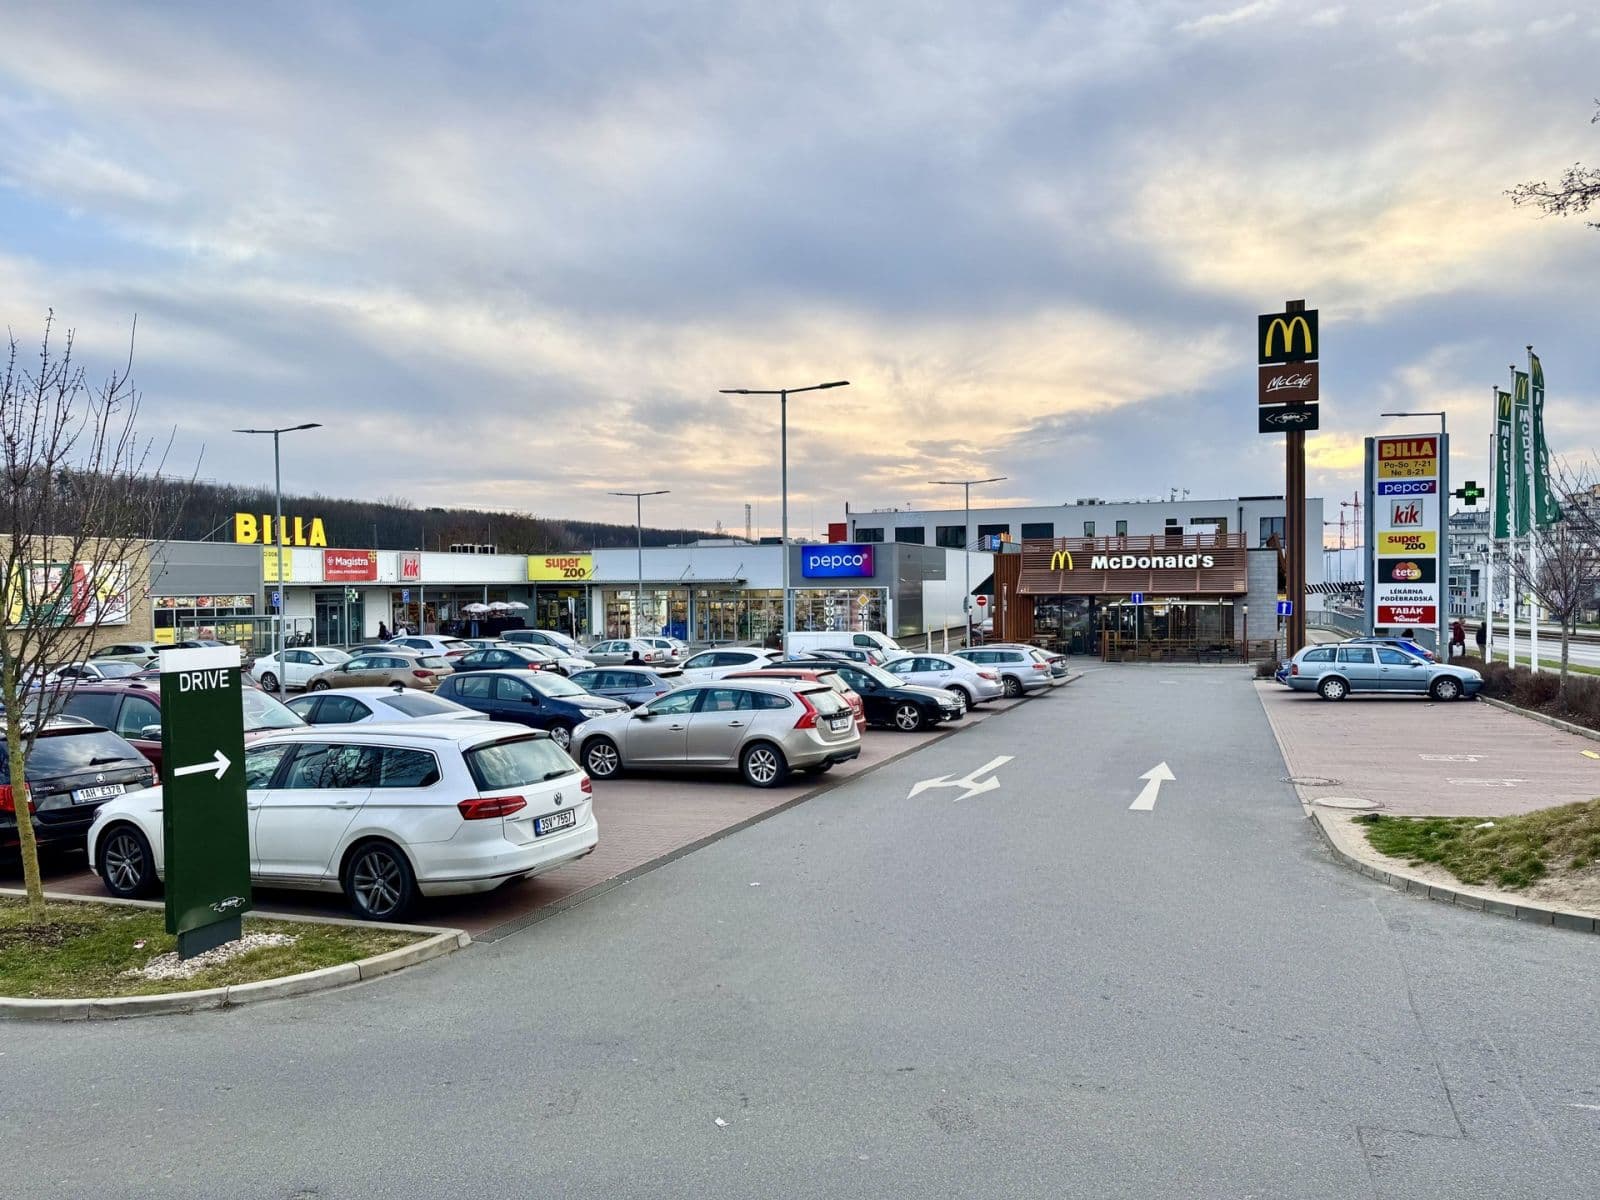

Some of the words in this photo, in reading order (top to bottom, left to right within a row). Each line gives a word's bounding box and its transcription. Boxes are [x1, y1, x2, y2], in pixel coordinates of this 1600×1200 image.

[1382, 441, 1433, 458] BILLA
[1384, 461, 1409, 470] Po-So
[1415, 460, 1431, 468] 7-21
[1384, 483, 1430, 494] pepco
[236, 512, 327, 547] BILLA
[1388, 535, 1421, 545] super
[545, 557, 580, 570] super
[809, 554, 865, 570] pepco
[1091, 554, 1214, 569] McDonald's
[563, 567, 586, 578] zoo
[1395, 567, 1417, 577] teta
[1390, 606, 1423, 614] TABÁK
[179, 669, 230, 692] DRIVE
[81, 788, 97, 800] 1AH
[541, 817, 553, 830] 3SV
[556, 812, 571, 826] 7557
